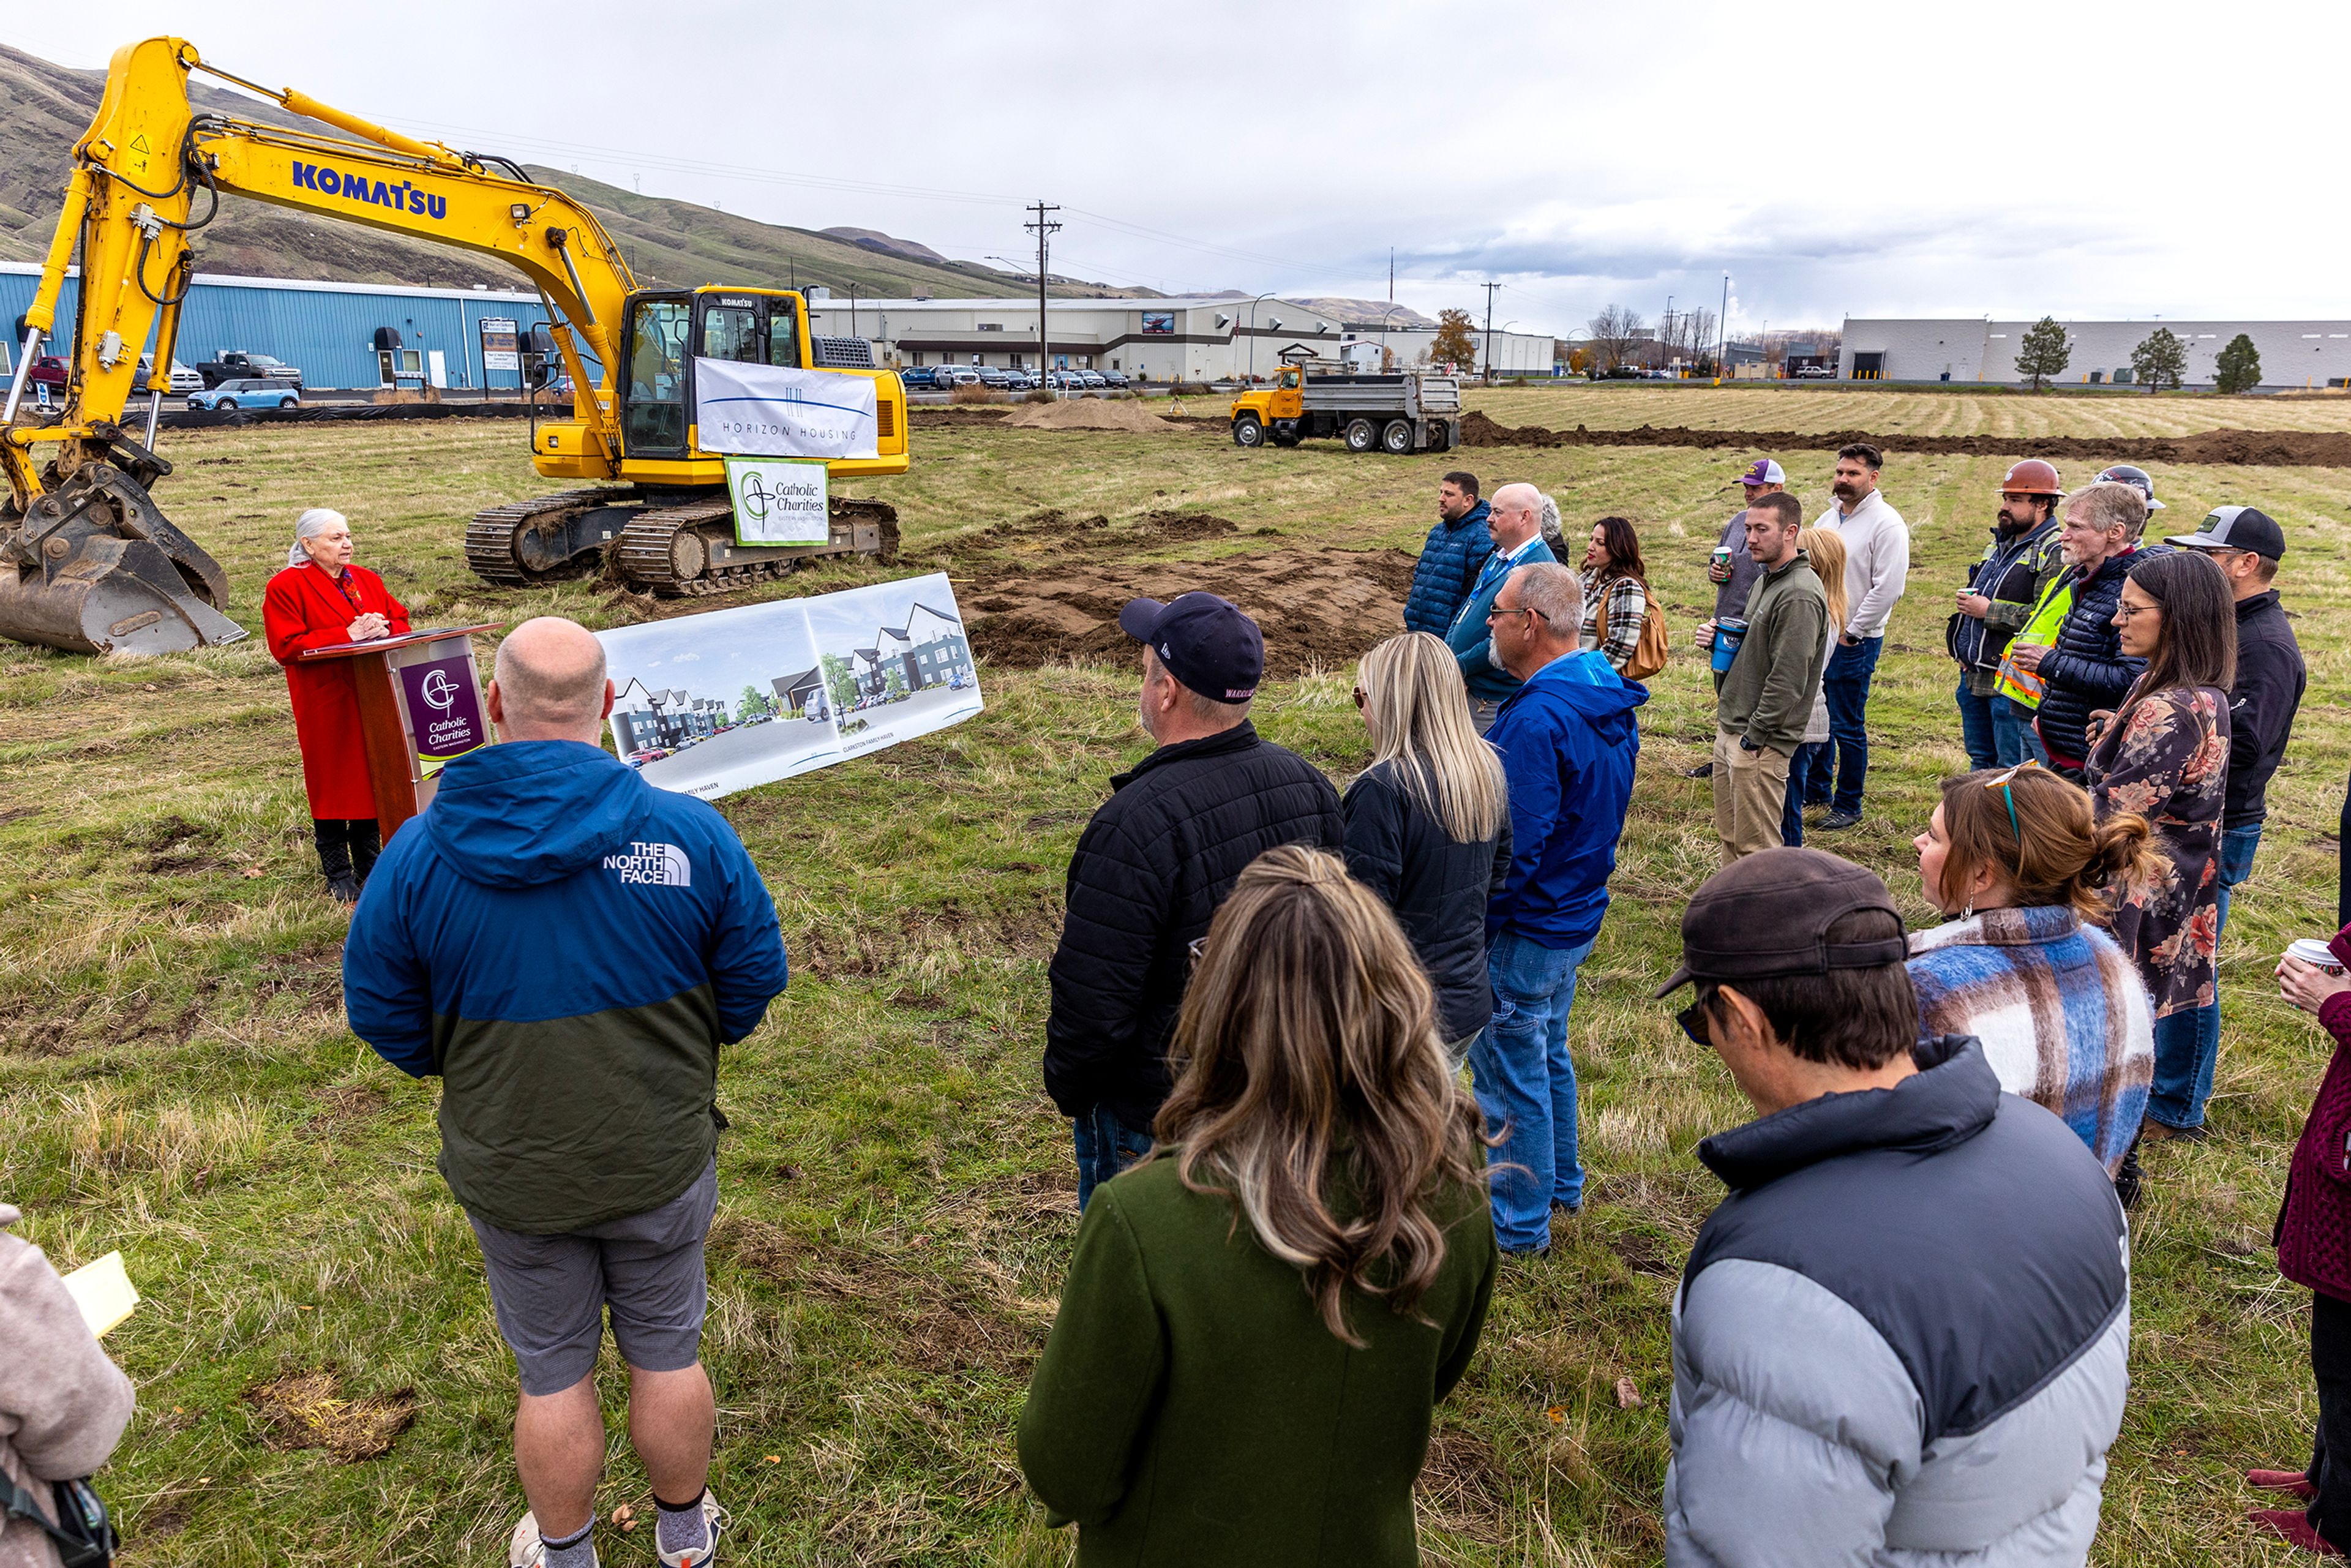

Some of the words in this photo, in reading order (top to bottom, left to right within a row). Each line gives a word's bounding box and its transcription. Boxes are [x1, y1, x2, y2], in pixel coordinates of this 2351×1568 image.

[293, 160, 446, 220] KOMATSU
[722, 298, 752, 307] KOMATSU
[723, 422, 790, 435] HORIZON
[800, 428, 856, 440] HOUSING
[776, 482, 818, 497] Catholic
[777, 497, 823, 512] Charities
[429, 716, 467, 733] Catholic
[429, 728, 471, 745] Charities
[842, 741, 866, 753] CLARKSTON
[866, 736, 880, 745] FAMILY
[880, 732, 894, 740] HAVEN
[699, 782, 719, 792] HAVEN
[630, 842, 664, 857] THE
[603, 855, 664, 871] NORTH
[621, 869, 664, 884] FACE
